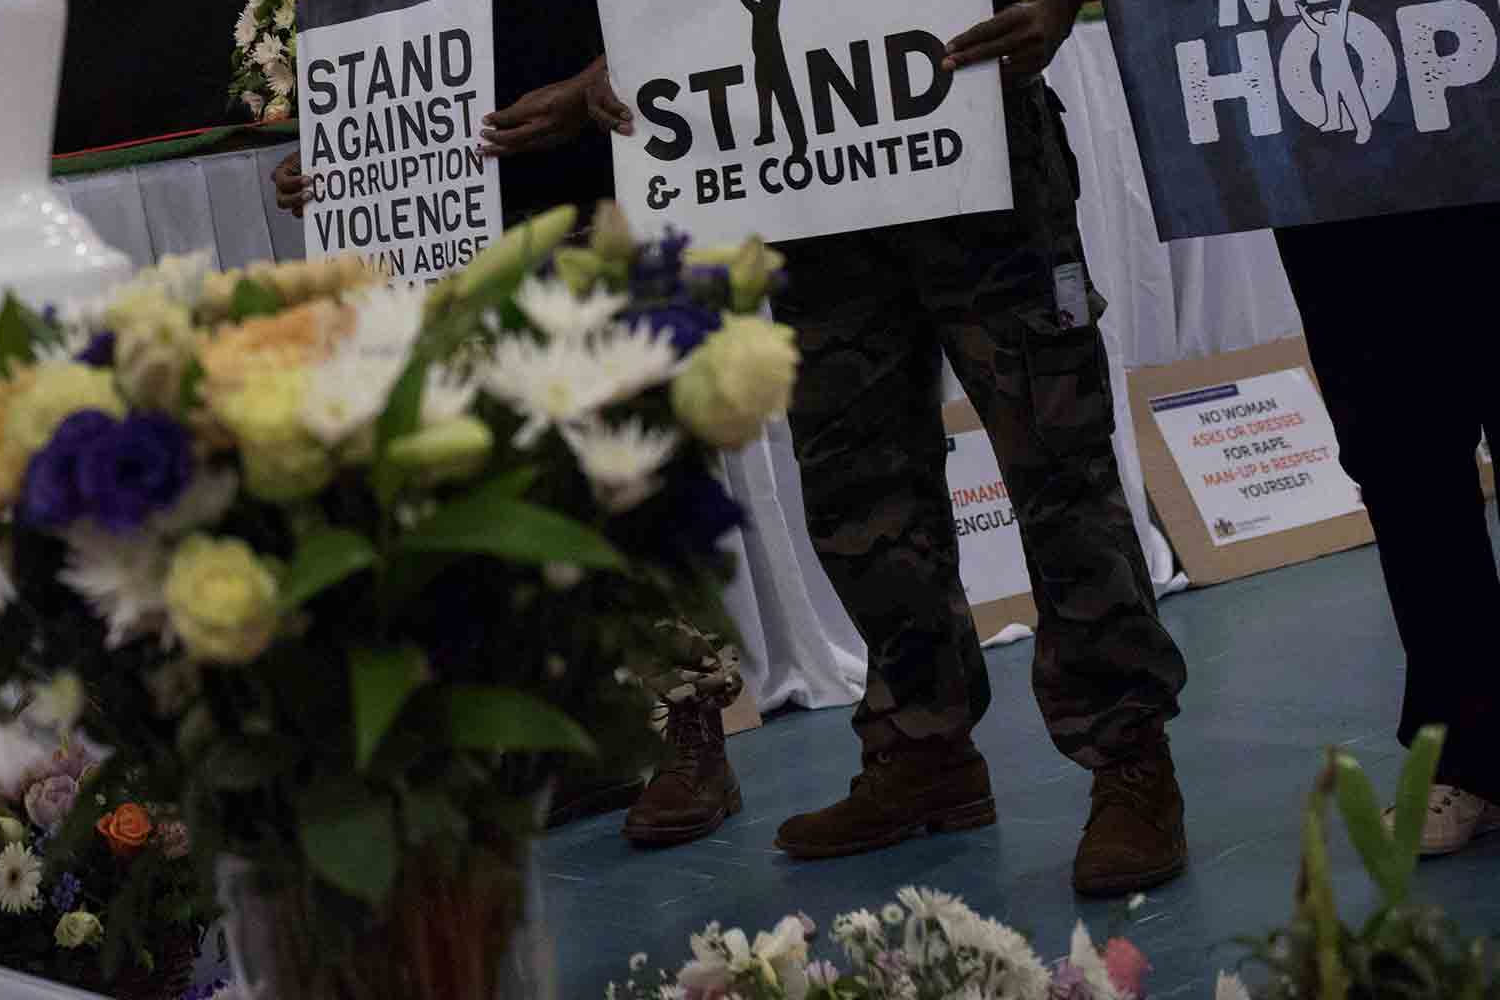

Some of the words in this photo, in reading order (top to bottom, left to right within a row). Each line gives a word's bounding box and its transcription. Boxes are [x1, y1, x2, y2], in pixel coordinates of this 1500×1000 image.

[307, 28, 473, 116] STAND
[636, 29, 954, 161] STAND
[1175, 0, 1500, 145] HOP
[311, 90, 477, 167] AGAINST
[312, 145, 485, 204] CORRUPTION
[646, 176, 680, 209] &
[695, 163, 747, 205] BE
[758, 127, 963, 195] COUNTED
[313, 185, 487, 251] VIOLENCE
[1199, 409, 1221, 425] NO
[1221, 398, 1279, 419] WOMAN
[1223, 446, 1252, 461] FOR
